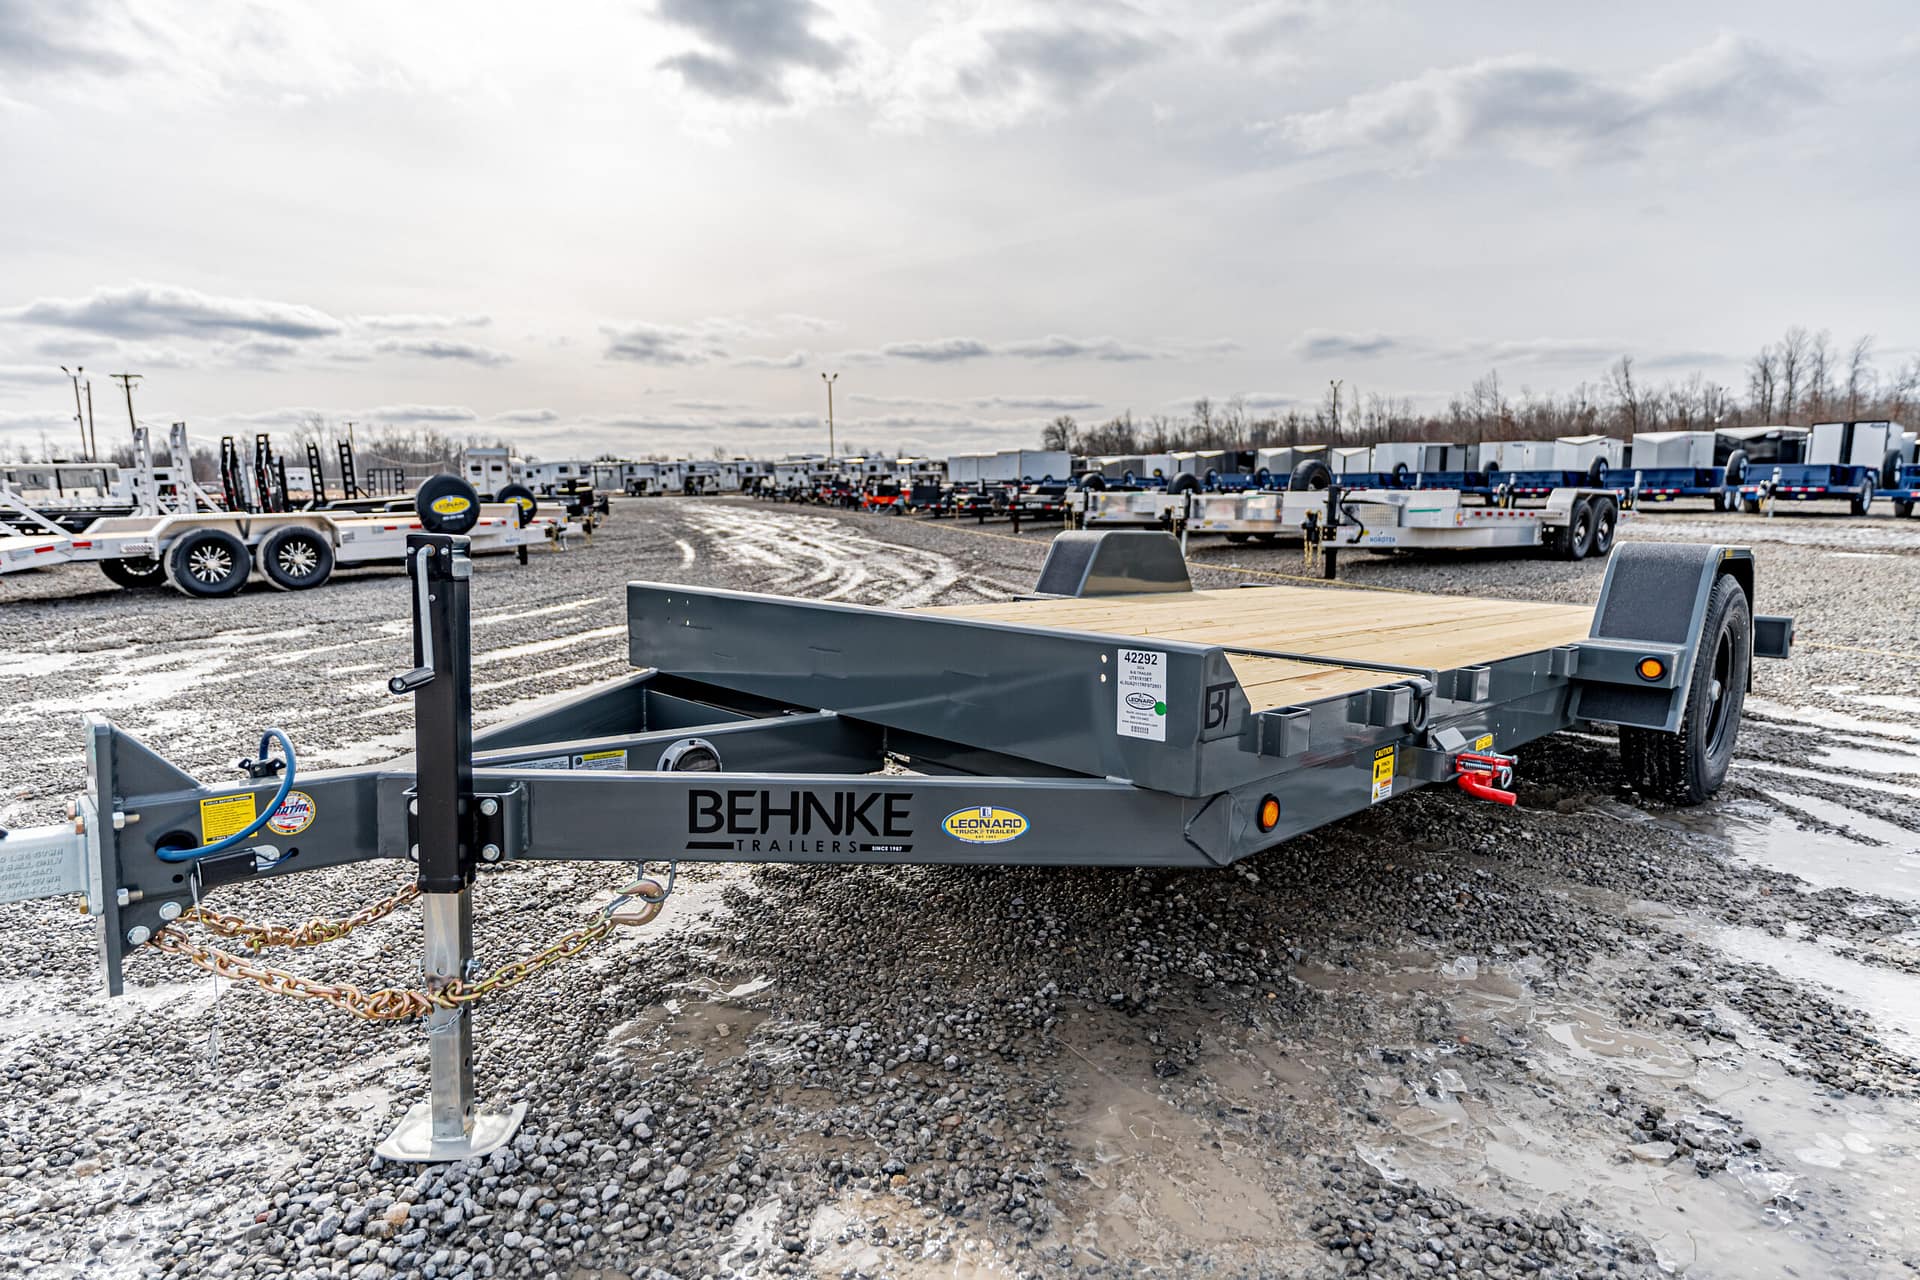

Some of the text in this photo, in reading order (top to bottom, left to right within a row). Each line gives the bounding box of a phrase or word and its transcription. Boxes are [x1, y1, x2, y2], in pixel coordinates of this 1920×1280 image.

[1124, 651, 1157, 665] 42292
[1128, 697, 1154, 705] LEONARD
[688, 789, 914, 837] BEHNKE
[950, 819, 1022, 828] LEONARD
[736, 839, 857, 853] TRAILERS
